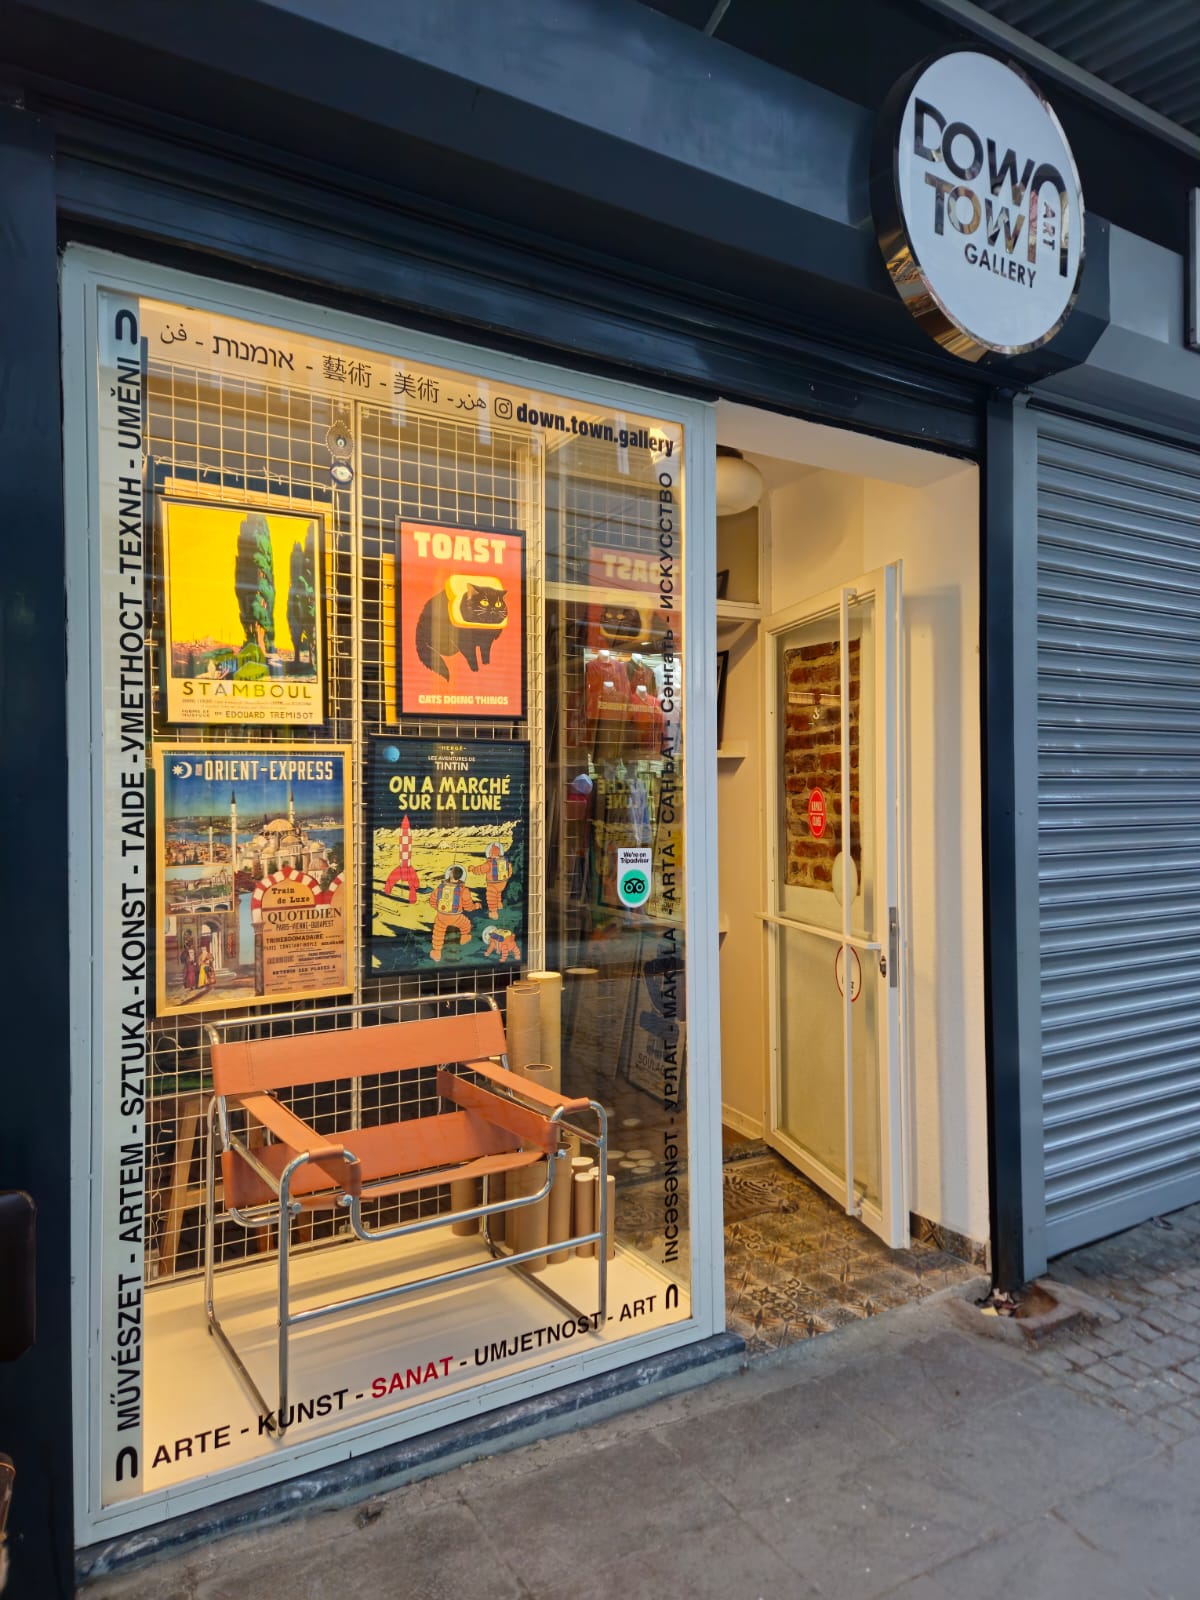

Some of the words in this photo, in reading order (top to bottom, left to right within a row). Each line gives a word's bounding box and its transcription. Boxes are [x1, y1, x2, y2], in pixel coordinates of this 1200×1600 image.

[1043, 201, 1056, 251] ART
[964, 243, 1036, 288] GALLERY
[213, 334, 294, 371] אומנות
[322, 354, 372, 389] 藝術
[394, 373, 439, 404] 美術
[517, 402, 674, 457] down.town.gallery
[414, 531, 506, 564] TOAST
[657, 472, 674, 609] ИСКУССТВО
[182, 681, 312, 698] STAMBOUL
[418, 694, 442, 704] CATS
[443, 694, 474, 705] DOING
[475, 695, 508, 706] THINGS
[389, 775, 416, 793] ON
[421, 776, 434, 793] A
[439, 774, 511, 795] MARCHÉ
[434, 761, 469, 771] TINTIN
[122, 772, 145, 857] TAIDE
[398, 794, 431, 810] SUR
[436, 795, 456, 810] LA
[462, 795, 502, 811] LUNE
[271, 887, 295, 895] Train
[277, 897, 287, 905] de
[289, 896, 310, 904] Luxe
[121, 882, 146, 981] KONST
[267, 908, 342, 925] QUOTIDIEN
[121, 1001, 146, 1115] SZTUKA
[120, 1142, 143, 1243] ARTEM
[110, 1273, 142, 1431] MŰVÉSZET
[151, 1424, 231, 1468] ARTE
[257, 1389, 349, 1435] KUNST
[371, 1355, 453, 1400] SANAT
[473, 1311, 602, 1367] UMJETNOST
[619, 1295, 657, 1322] ART
